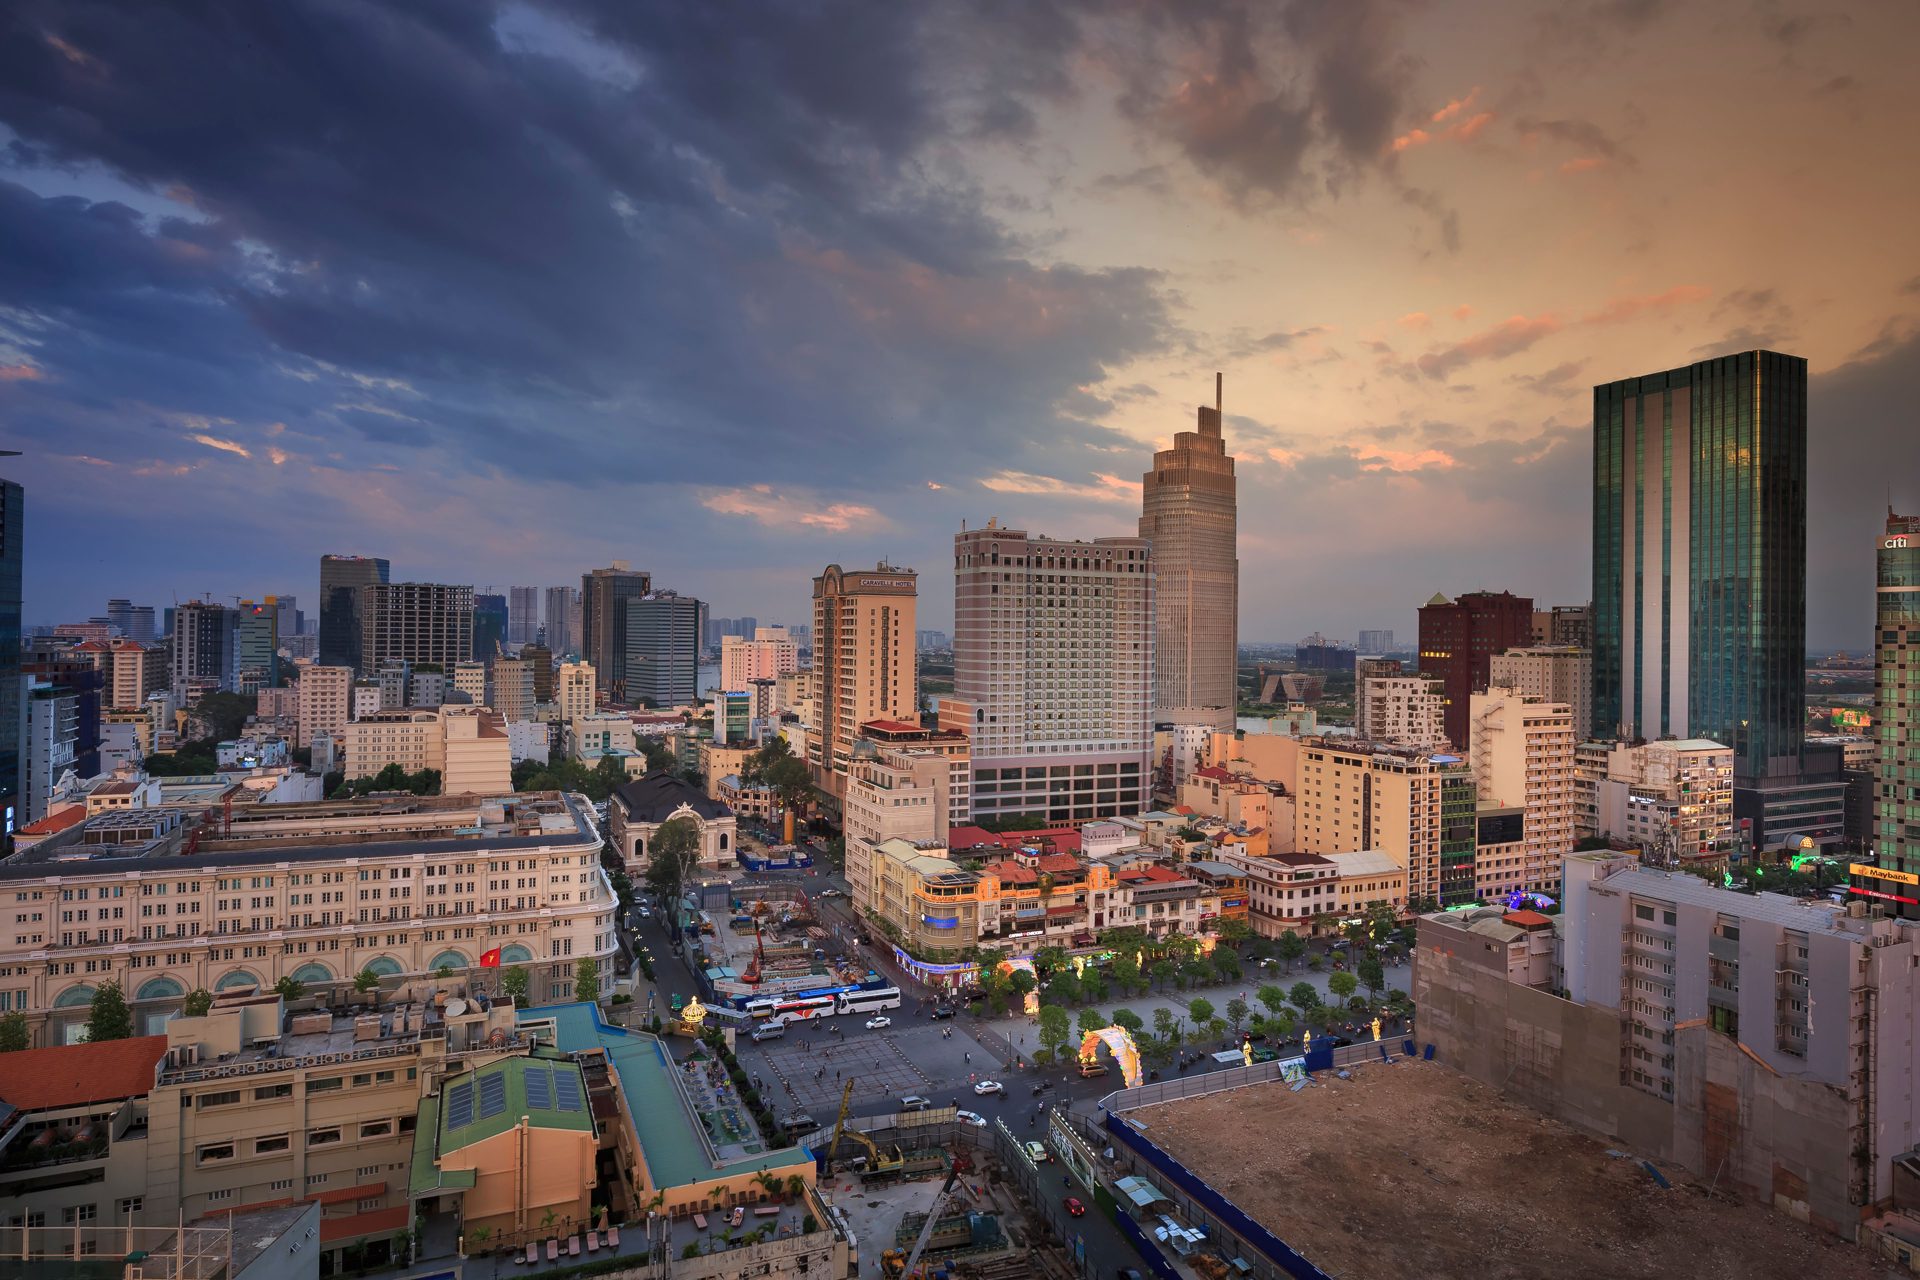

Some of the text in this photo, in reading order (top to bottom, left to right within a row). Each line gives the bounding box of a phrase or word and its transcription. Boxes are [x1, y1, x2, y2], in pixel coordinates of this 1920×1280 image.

[992, 531, 1024, 540] Sheraton
[1884, 537, 1907, 549] citi
[1869, 869, 1909, 881] Maybank
